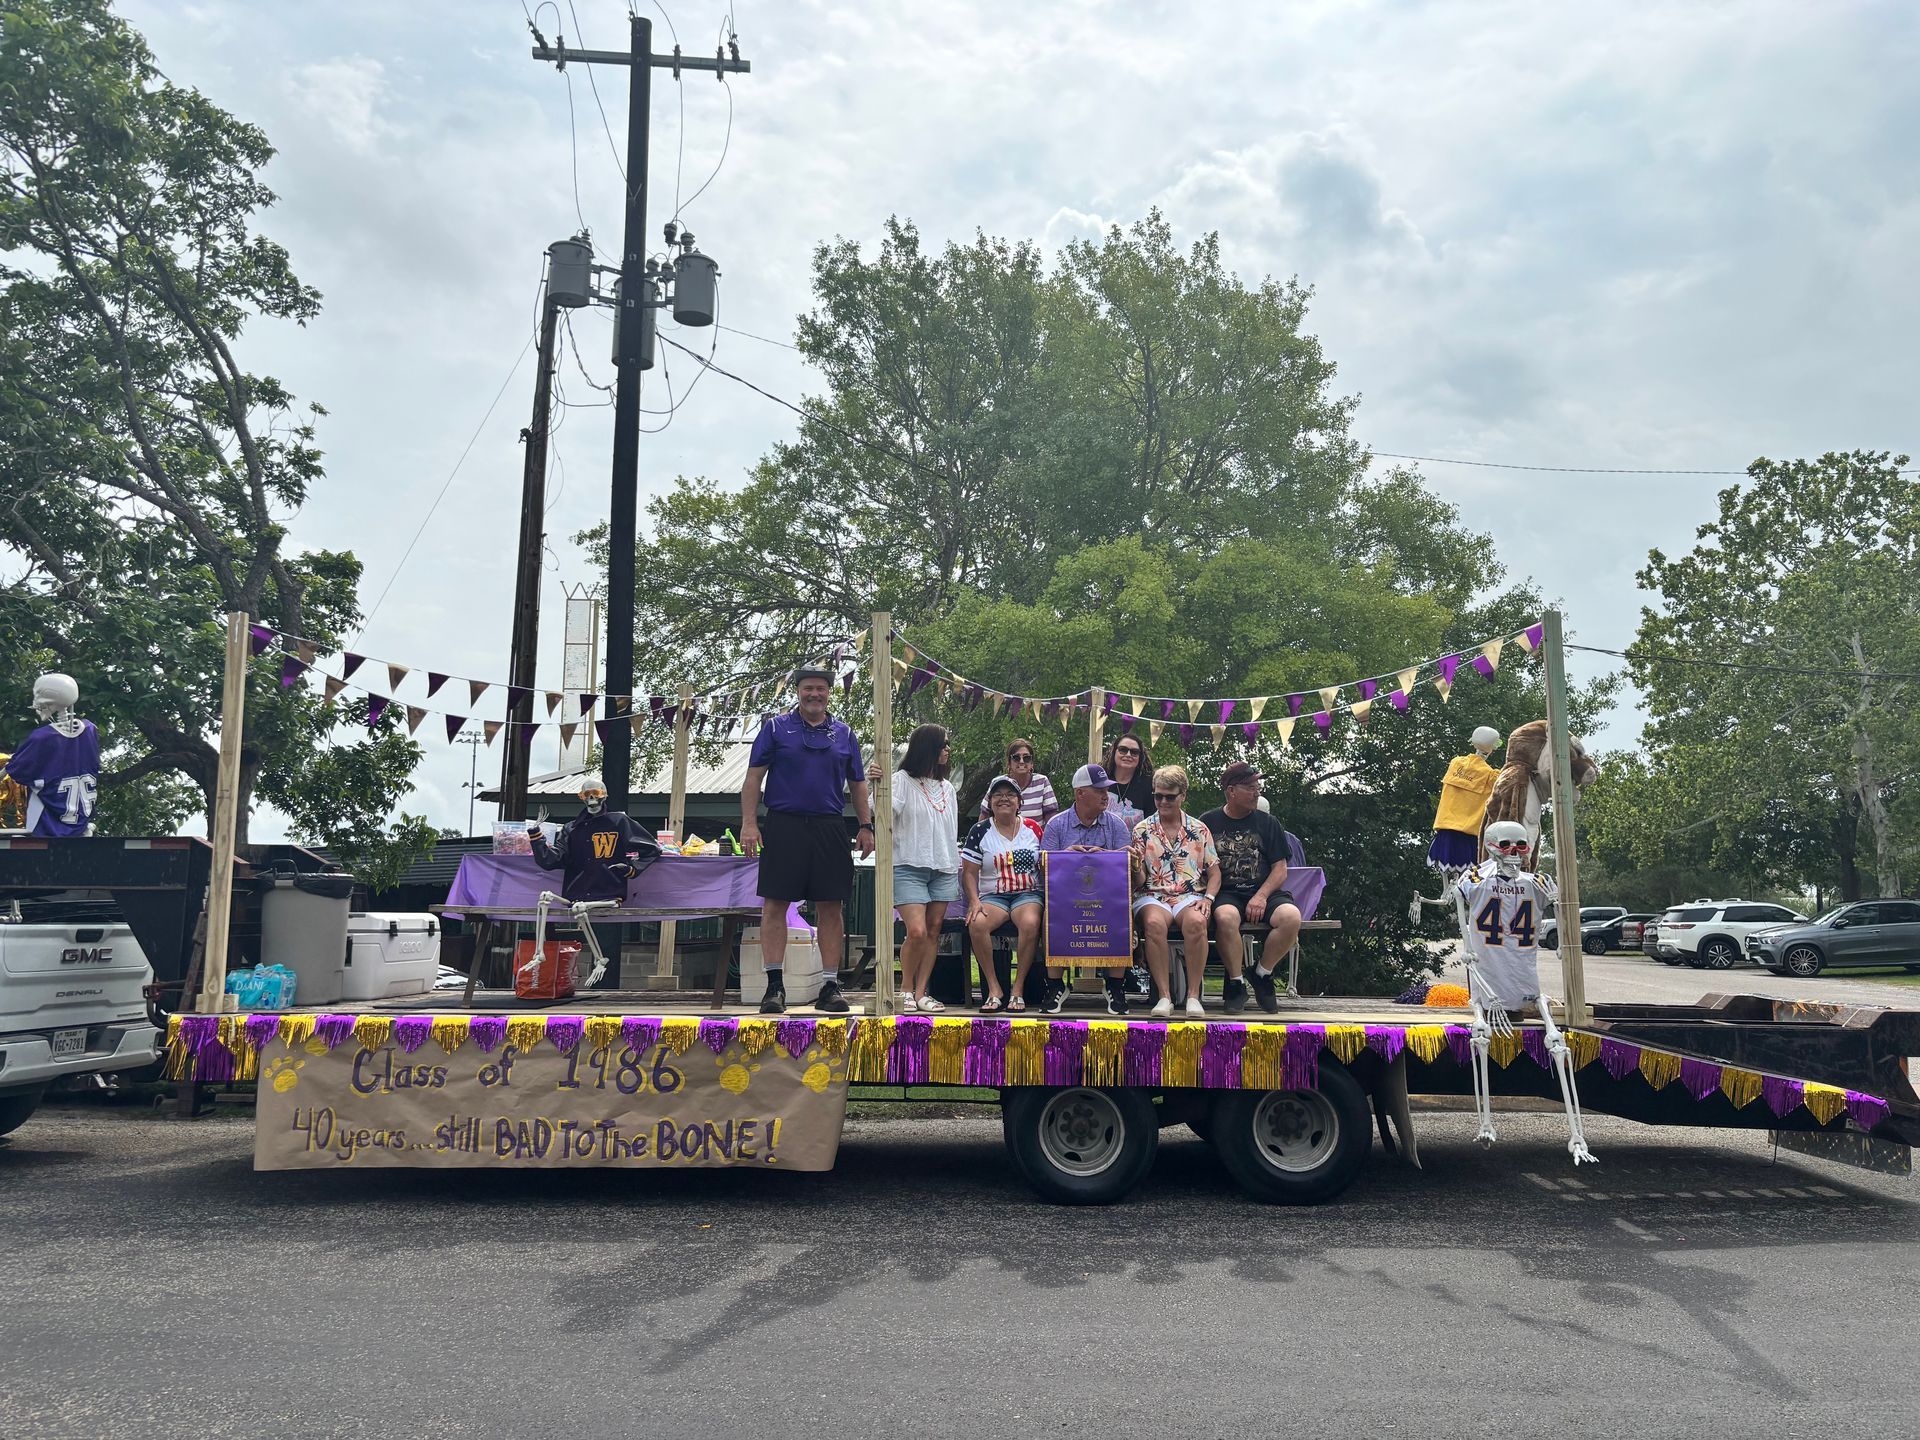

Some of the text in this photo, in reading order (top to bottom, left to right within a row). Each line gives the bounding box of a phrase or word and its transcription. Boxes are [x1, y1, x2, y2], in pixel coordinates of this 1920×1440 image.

[57, 773, 98, 825] 76
[592, 831, 619, 859] W
[1491, 884, 1526, 895] WEIMAR
[1071, 924, 1108, 934] 1ST PLACE
[1475, 897, 1537, 948] 44
[60, 948, 113, 965] GMC
[55, 988, 103, 998] DENALI
[351, 1041, 686, 1098] Class of 1986
[291, 1106, 336, 1151] 40
[494, 1116, 556, 1159] BAD
[651, 1116, 782, 1164] BONE!
